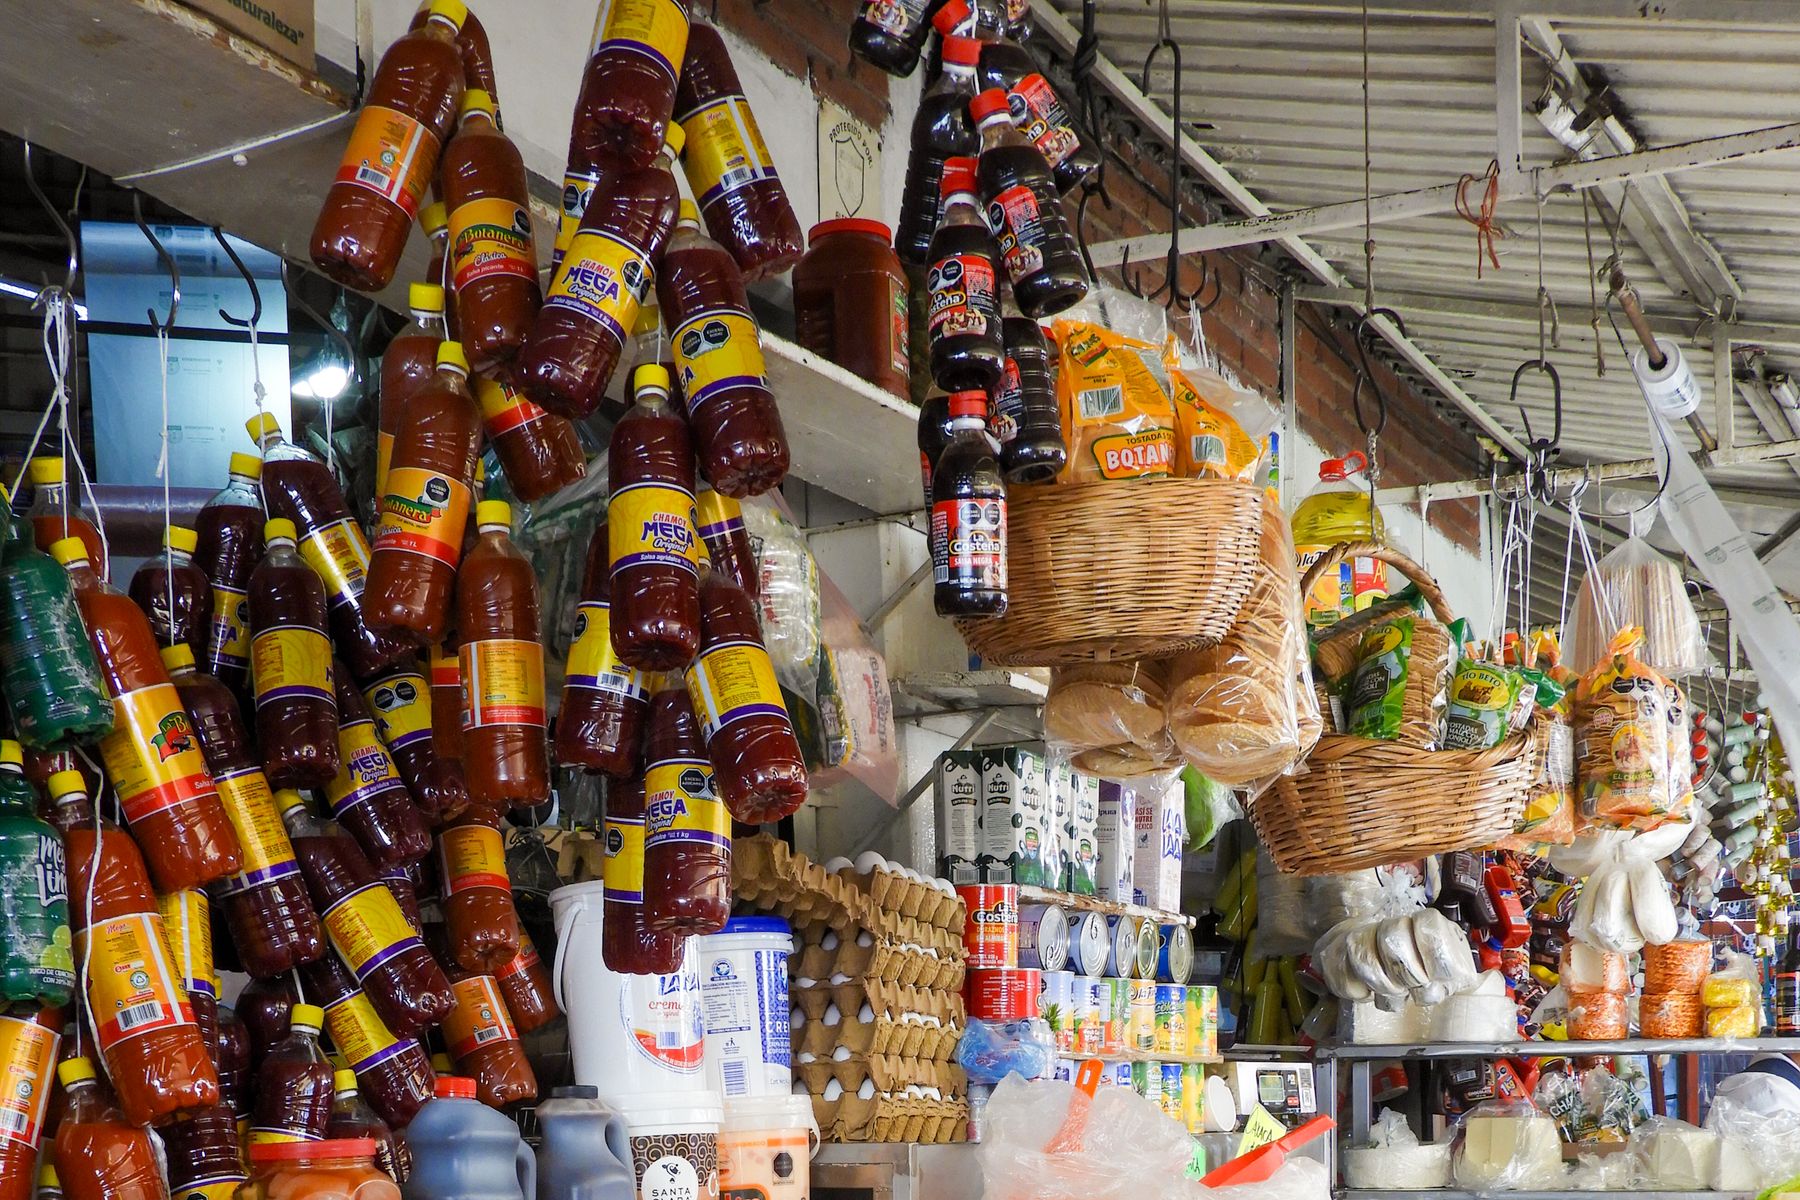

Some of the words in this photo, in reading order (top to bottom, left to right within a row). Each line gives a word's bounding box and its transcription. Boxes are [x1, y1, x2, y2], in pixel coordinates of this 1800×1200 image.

[829, 121, 862, 142] PROTEGIDO
[464, 227, 526, 250] Botanera
[474, 251, 507, 267] Clásica
[579, 259, 615, 278] CHAMOY
[561, 266, 621, 303] MEGA
[567, 283, 607, 304] Original
[652, 512, 688, 527] CHAMOY
[641, 521, 695, 548] MEGA
[973, 533, 985, 542] La
[652, 538, 688, 555] Original
[953, 541, 1000, 552] Costeña
[972, 557, 993, 565] NEGRA
[1479, 672, 1501, 688] BETO
[346, 752, 392, 780] MEGA
[362, 766, 389, 783] Original
[1613, 773, 1623, 781] EL
[952, 783, 975, 794] Nutri
[988, 782, 1009, 793] Nutri
[1135, 815, 1153, 823] NUTRE
[652, 1187, 691, 1197] SANTA
